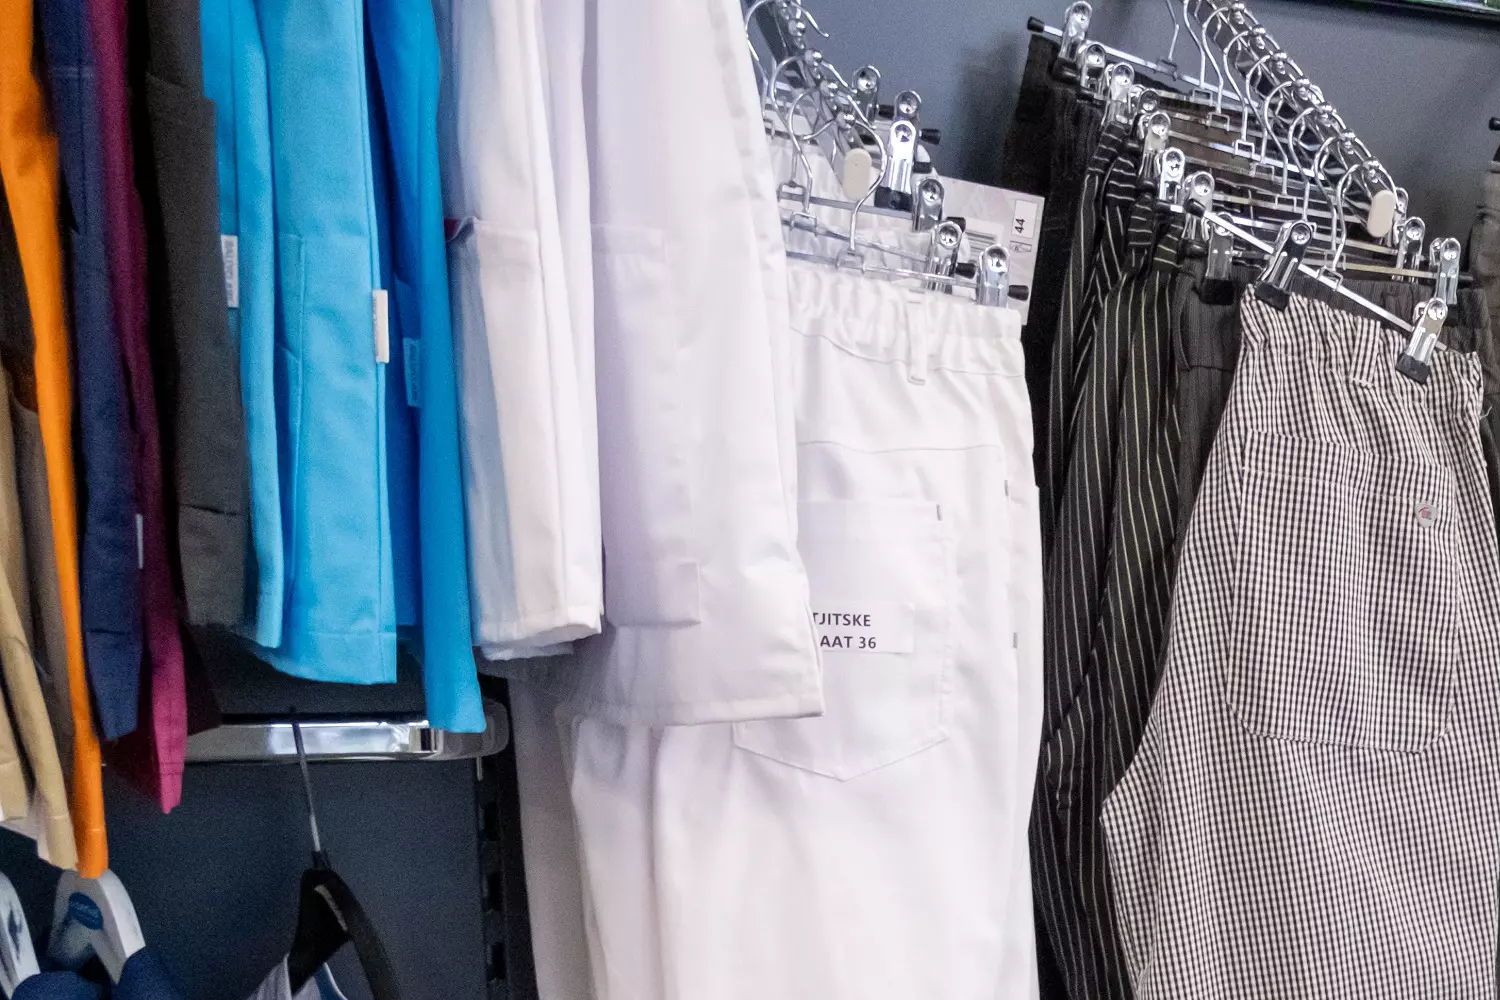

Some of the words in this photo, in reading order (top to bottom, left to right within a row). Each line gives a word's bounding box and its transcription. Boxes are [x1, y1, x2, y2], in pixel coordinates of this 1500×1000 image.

[1014, 218, 1026, 234] 44
[820, 635, 854, 648] AAT
[858, 636, 877, 649] 36
